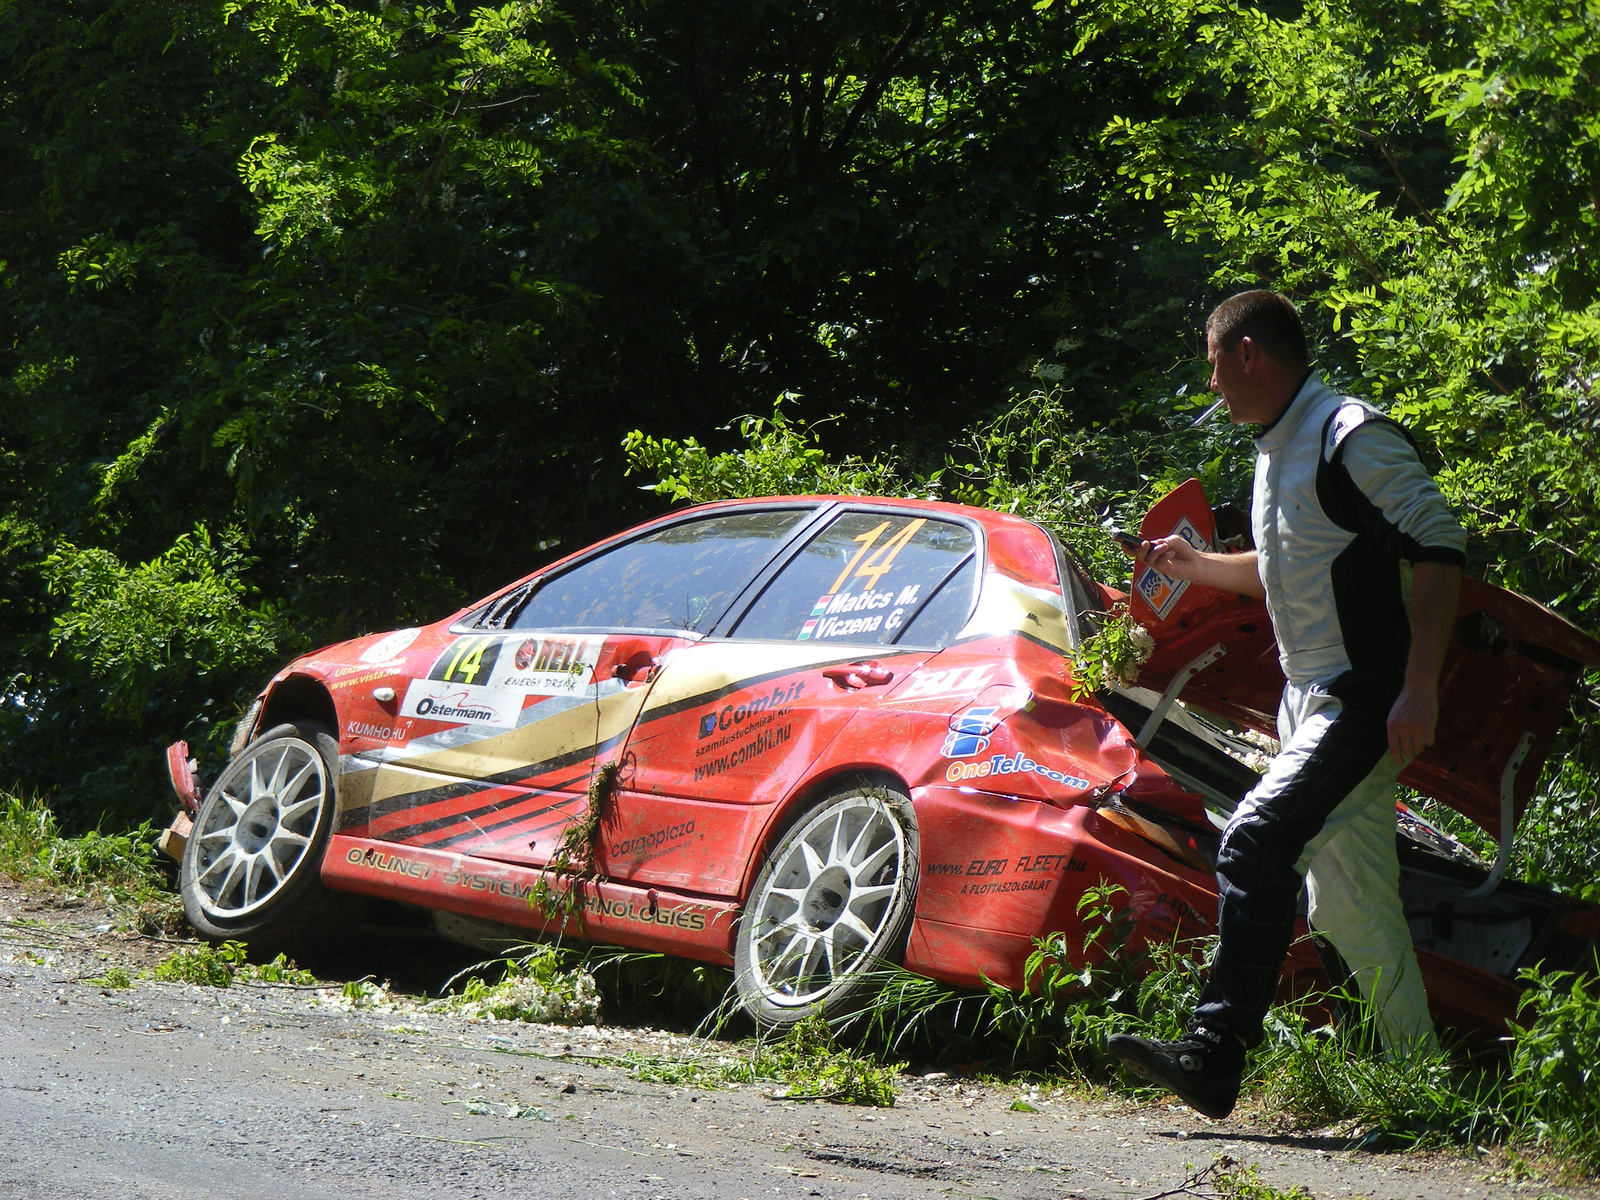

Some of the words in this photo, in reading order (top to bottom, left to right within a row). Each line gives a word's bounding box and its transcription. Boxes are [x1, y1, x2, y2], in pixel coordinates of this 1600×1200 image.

[828, 518, 928, 595] 14
[825, 590, 894, 615] Matics
[893, 584, 921, 606] M.
[815, 615, 884, 639] Viczena
[884, 608, 904, 630] G.
[443, 635, 498, 685] 14
[504, 676, 544, 687] ENERGY
[543, 678, 578, 691] DRINK
[415, 697, 492, 721] Ostermann
[718, 680, 805, 731] Combit
[693, 723, 792, 782] www.combit.hu
[945, 752, 1090, 791] OneTelecom
[610, 819, 697, 858] cargoplaza
[346, 846, 431, 881] ONLINET
[959, 884, 968, 895] A
[969, 877, 1053, 895] FLOTTASZOLGÁLAT
